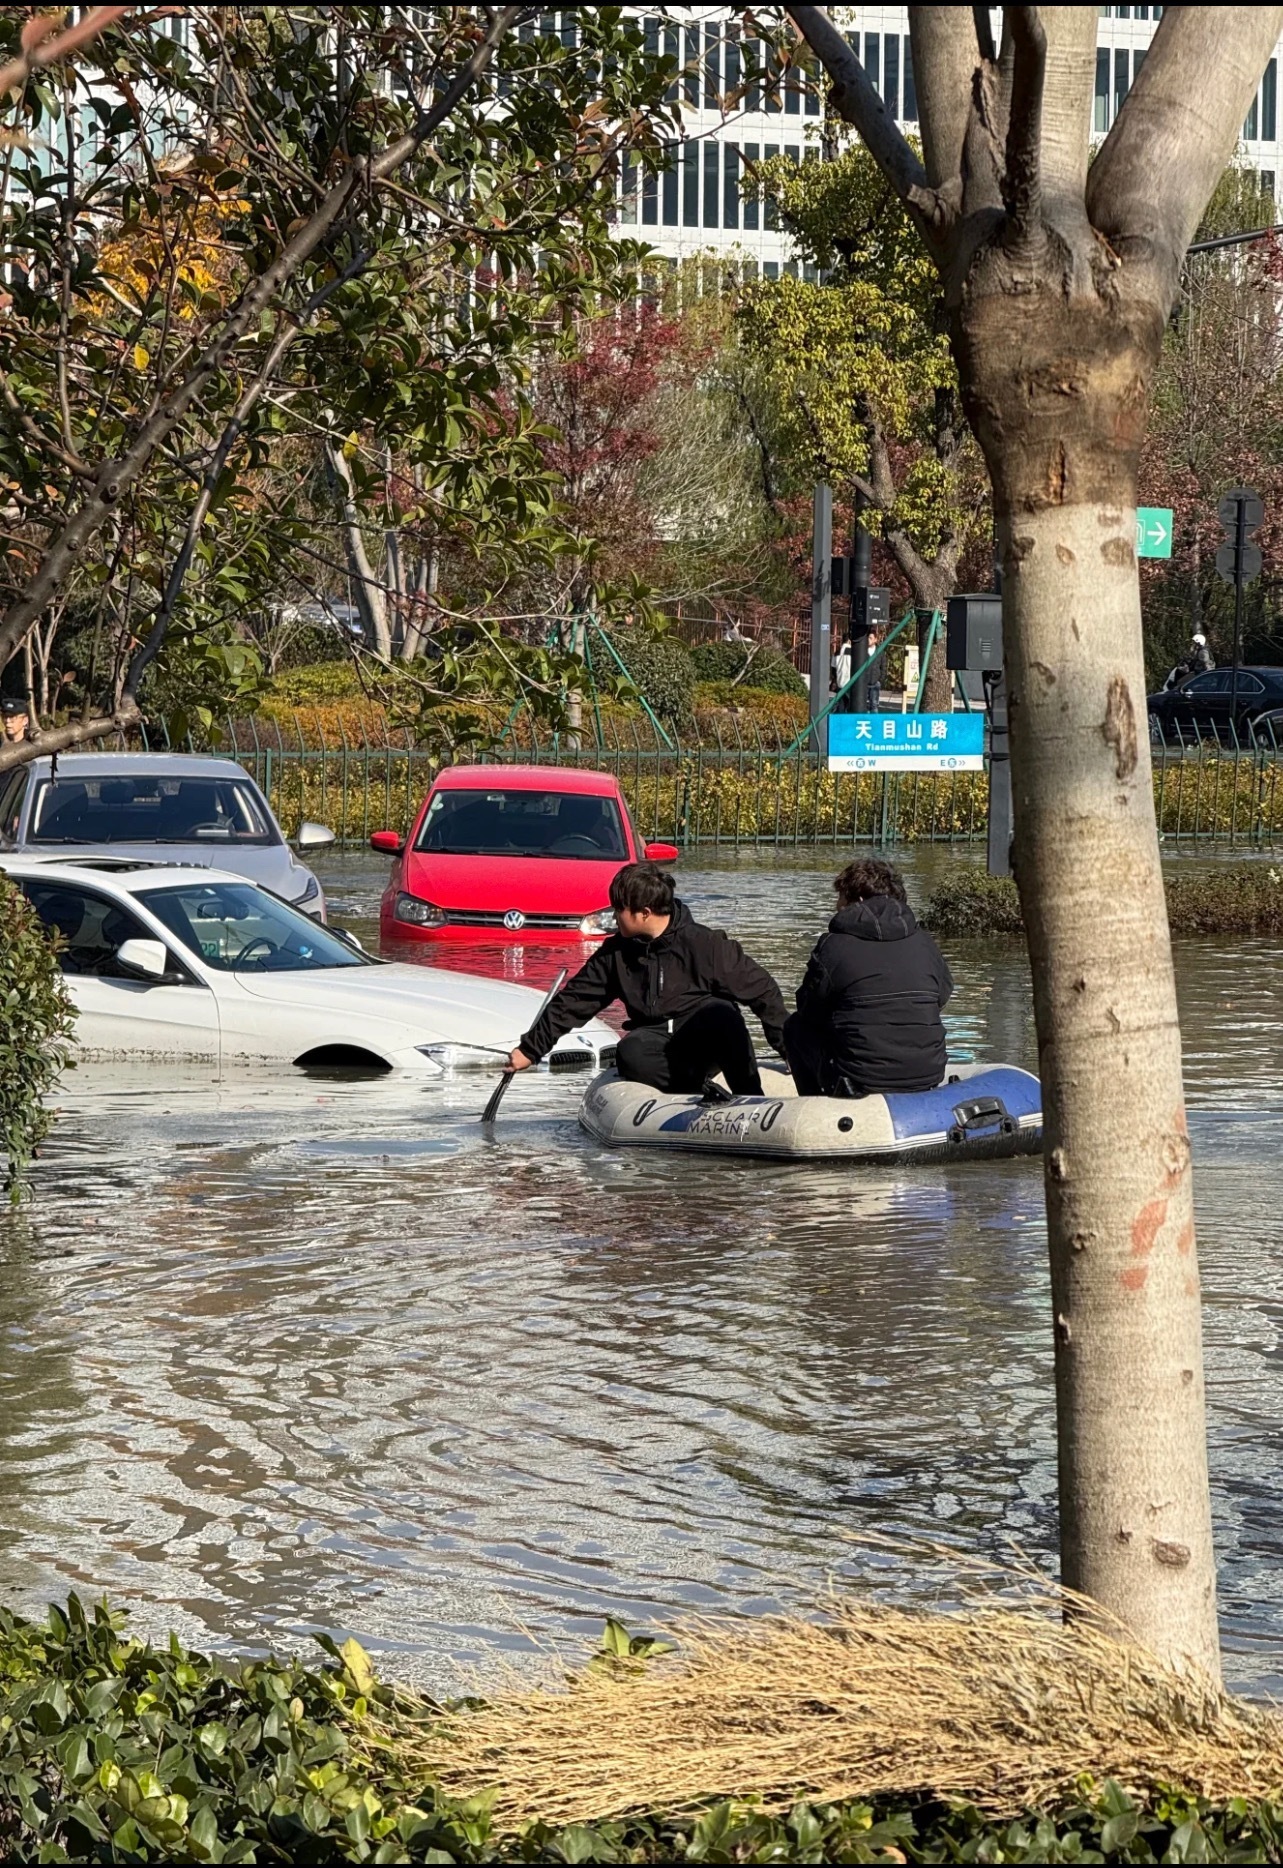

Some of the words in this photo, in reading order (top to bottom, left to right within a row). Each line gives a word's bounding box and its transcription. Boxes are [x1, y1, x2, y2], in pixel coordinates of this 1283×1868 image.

[855, 719, 948, 740] 天目山路
[865, 743, 922, 751] Tianmushan
[926, 743, 939, 751] Rd
[686, 1122, 750, 1135] MARIN
